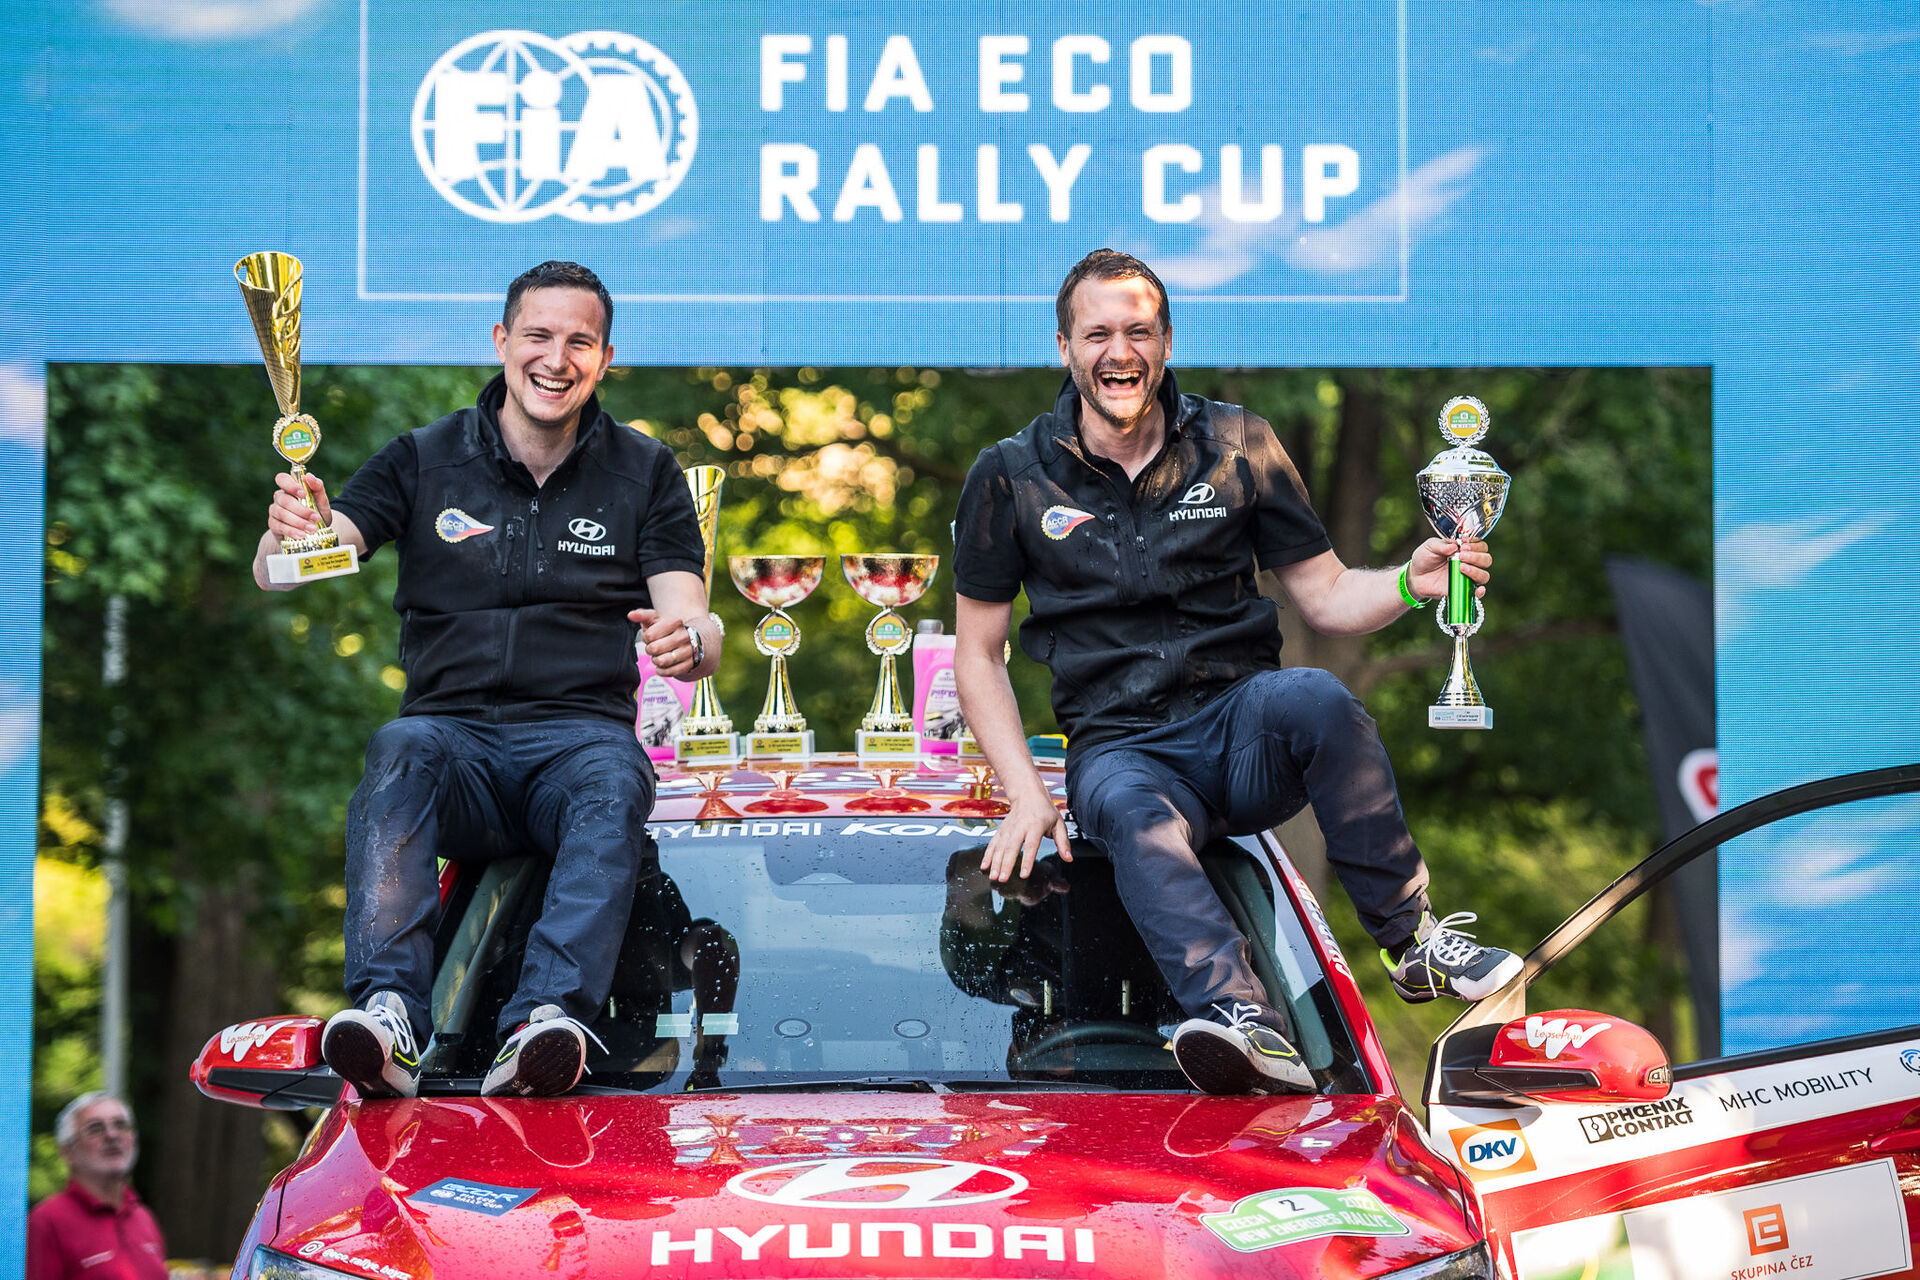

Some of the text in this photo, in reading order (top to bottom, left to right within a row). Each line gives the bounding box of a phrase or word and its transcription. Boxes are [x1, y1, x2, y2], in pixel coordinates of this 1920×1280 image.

[761, 35, 1192, 112] FIA ECO
[760, 143, 1360, 222] RALLY CUP
[1169, 507, 1227, 521] HYUNDAI
[440, 519, 465, 532] ACCR
[557, 540, 615, 556] HYUNDAI
[839, 822, 998, 837] KON
[226, 1033, 264, 1043] LeasePlan
[1534, 1029, 1582, 1041] LeasePlan
[1719, 1067, 1873, 1112] MHC MOBILITY
[1613, 1110, 1694, 1137] CONTACT
[1468, 1137, 1517, 1163] DKV
[1278, 1199, 1304, 1212] 2
[1217, 1214, 1271, 1231] CZECH
[1233, 1211, 1394, 1244] NEW ENERGIES RALLYE
[651, 1222, 1095, 1266] HYUNDAI
[1731, 1255, 1814, 1280] SKUPINA ČEZ
